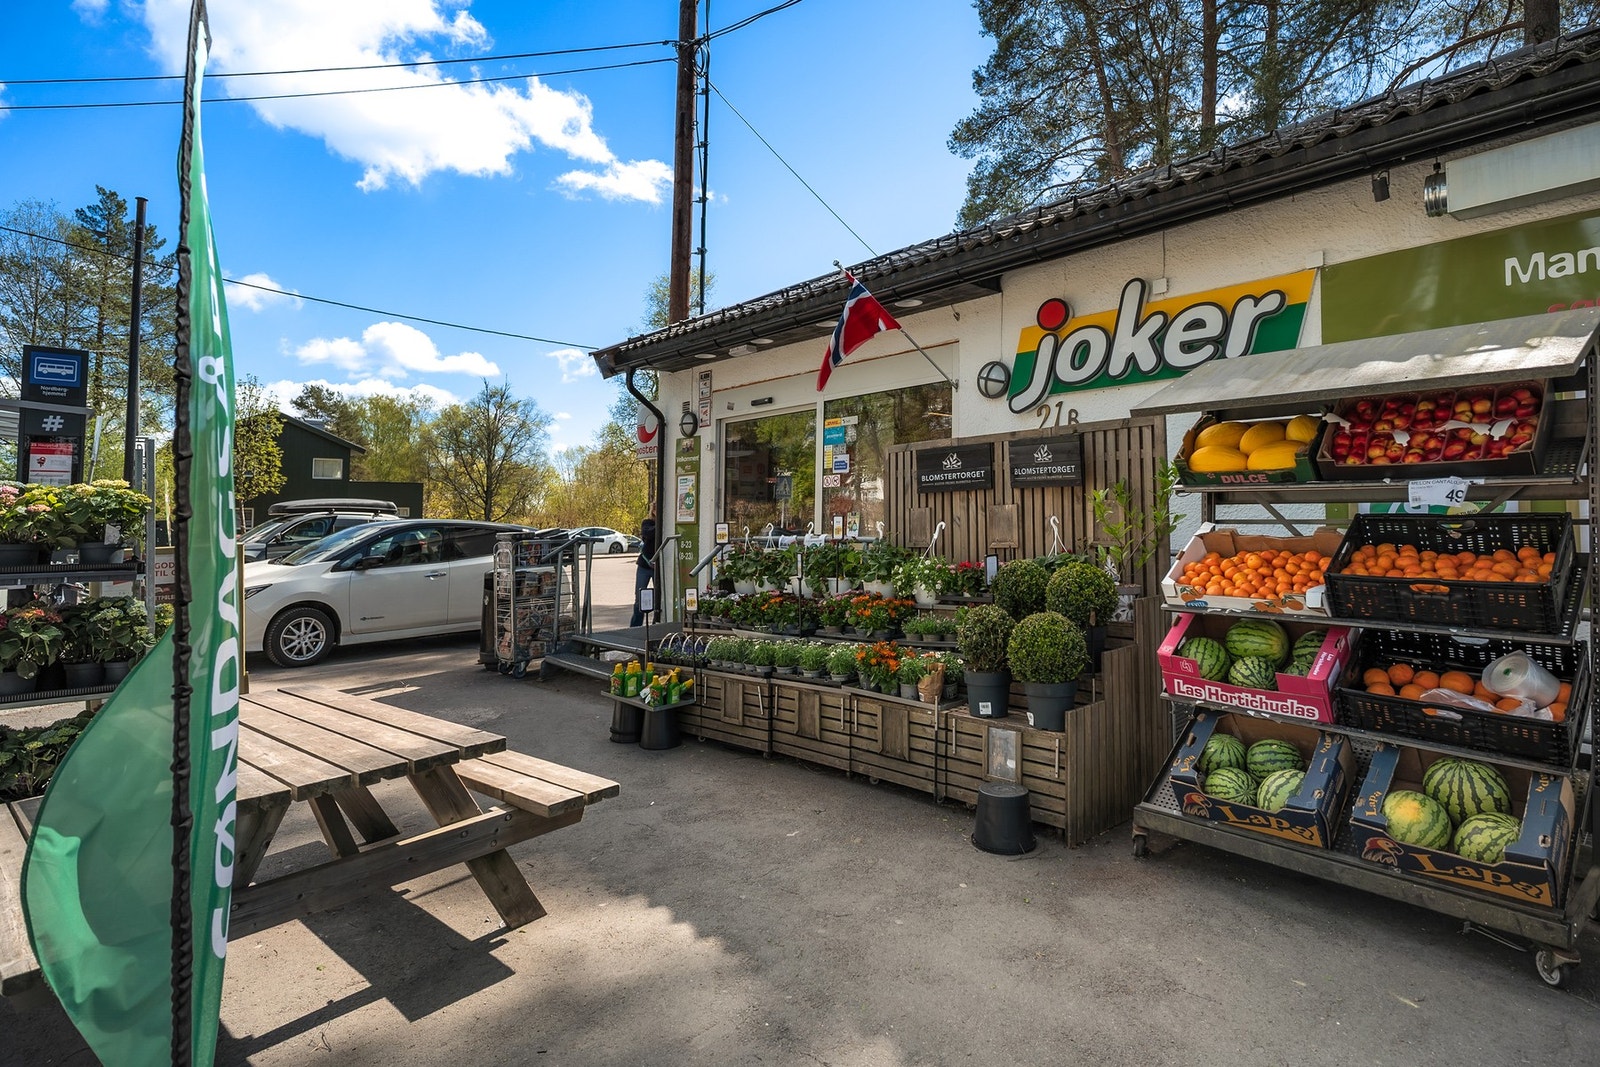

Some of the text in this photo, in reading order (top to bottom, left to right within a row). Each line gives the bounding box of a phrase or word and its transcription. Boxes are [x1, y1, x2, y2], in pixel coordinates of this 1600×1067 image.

[1008, 278, 1287, 413] joker
[921, 470, 985, 482] BLOMSTERTORGET
[1014, 465, 1076, 475] BLOMSTERTORGET
[1220, 474, 1269, 484] DULCE
[1174, 679, 1319, 720] Las Hortichuelas
[1365, 790, 1383, 817] Lapa
[1216, 805, 1314, 841] Lapa
[1408, 853, 1544, 899] Lapa
